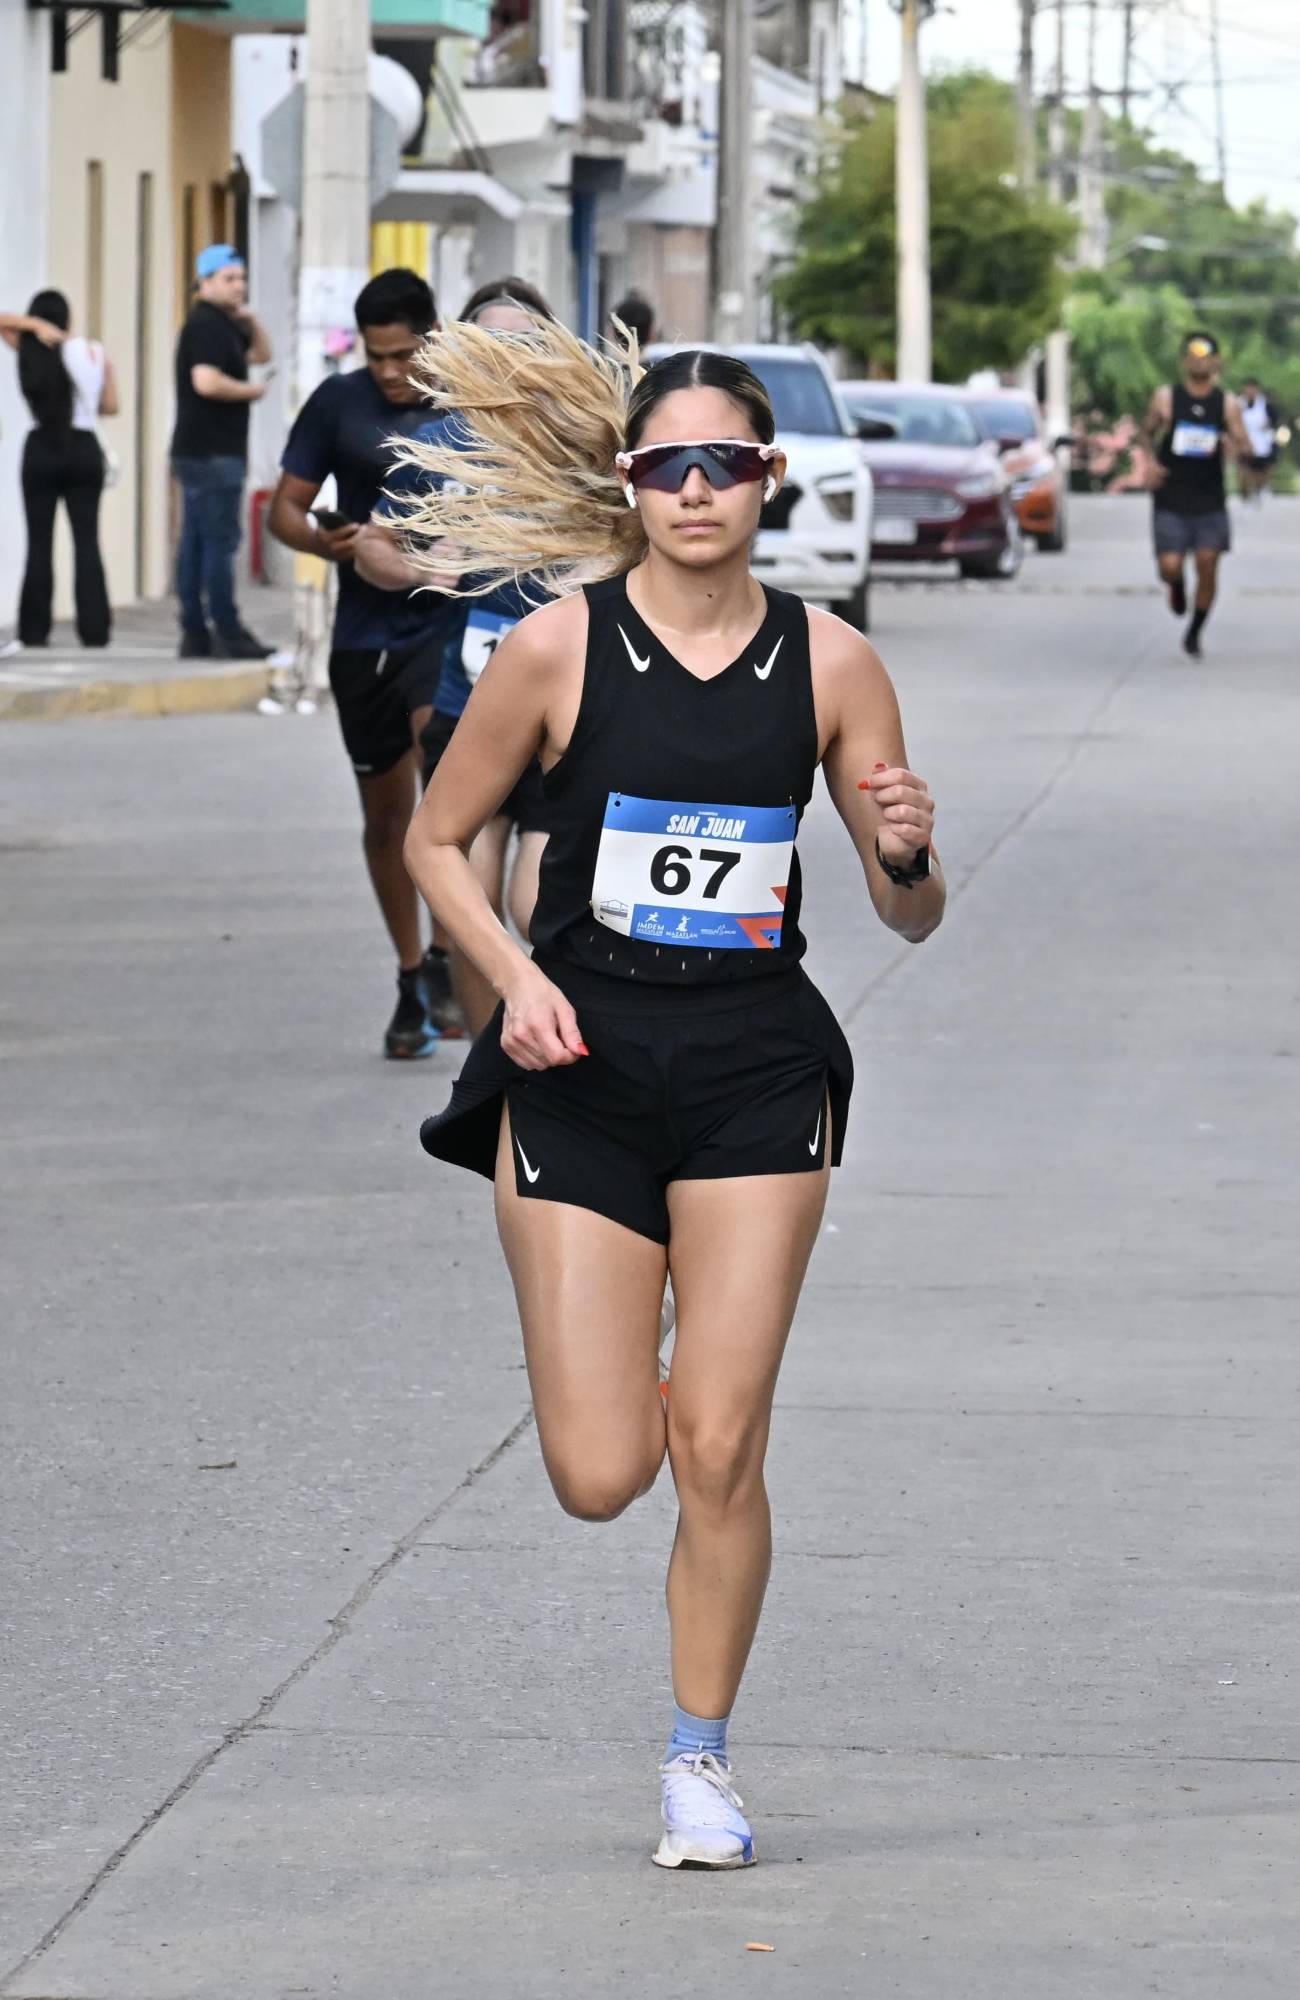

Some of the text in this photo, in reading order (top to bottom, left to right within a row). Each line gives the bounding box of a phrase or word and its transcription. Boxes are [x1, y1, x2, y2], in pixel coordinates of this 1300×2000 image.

[666, 814, 746, 839] SAN JUAN
[650, 844, 741, 899] 67
[637, 921, 664, 931] IMDEM
